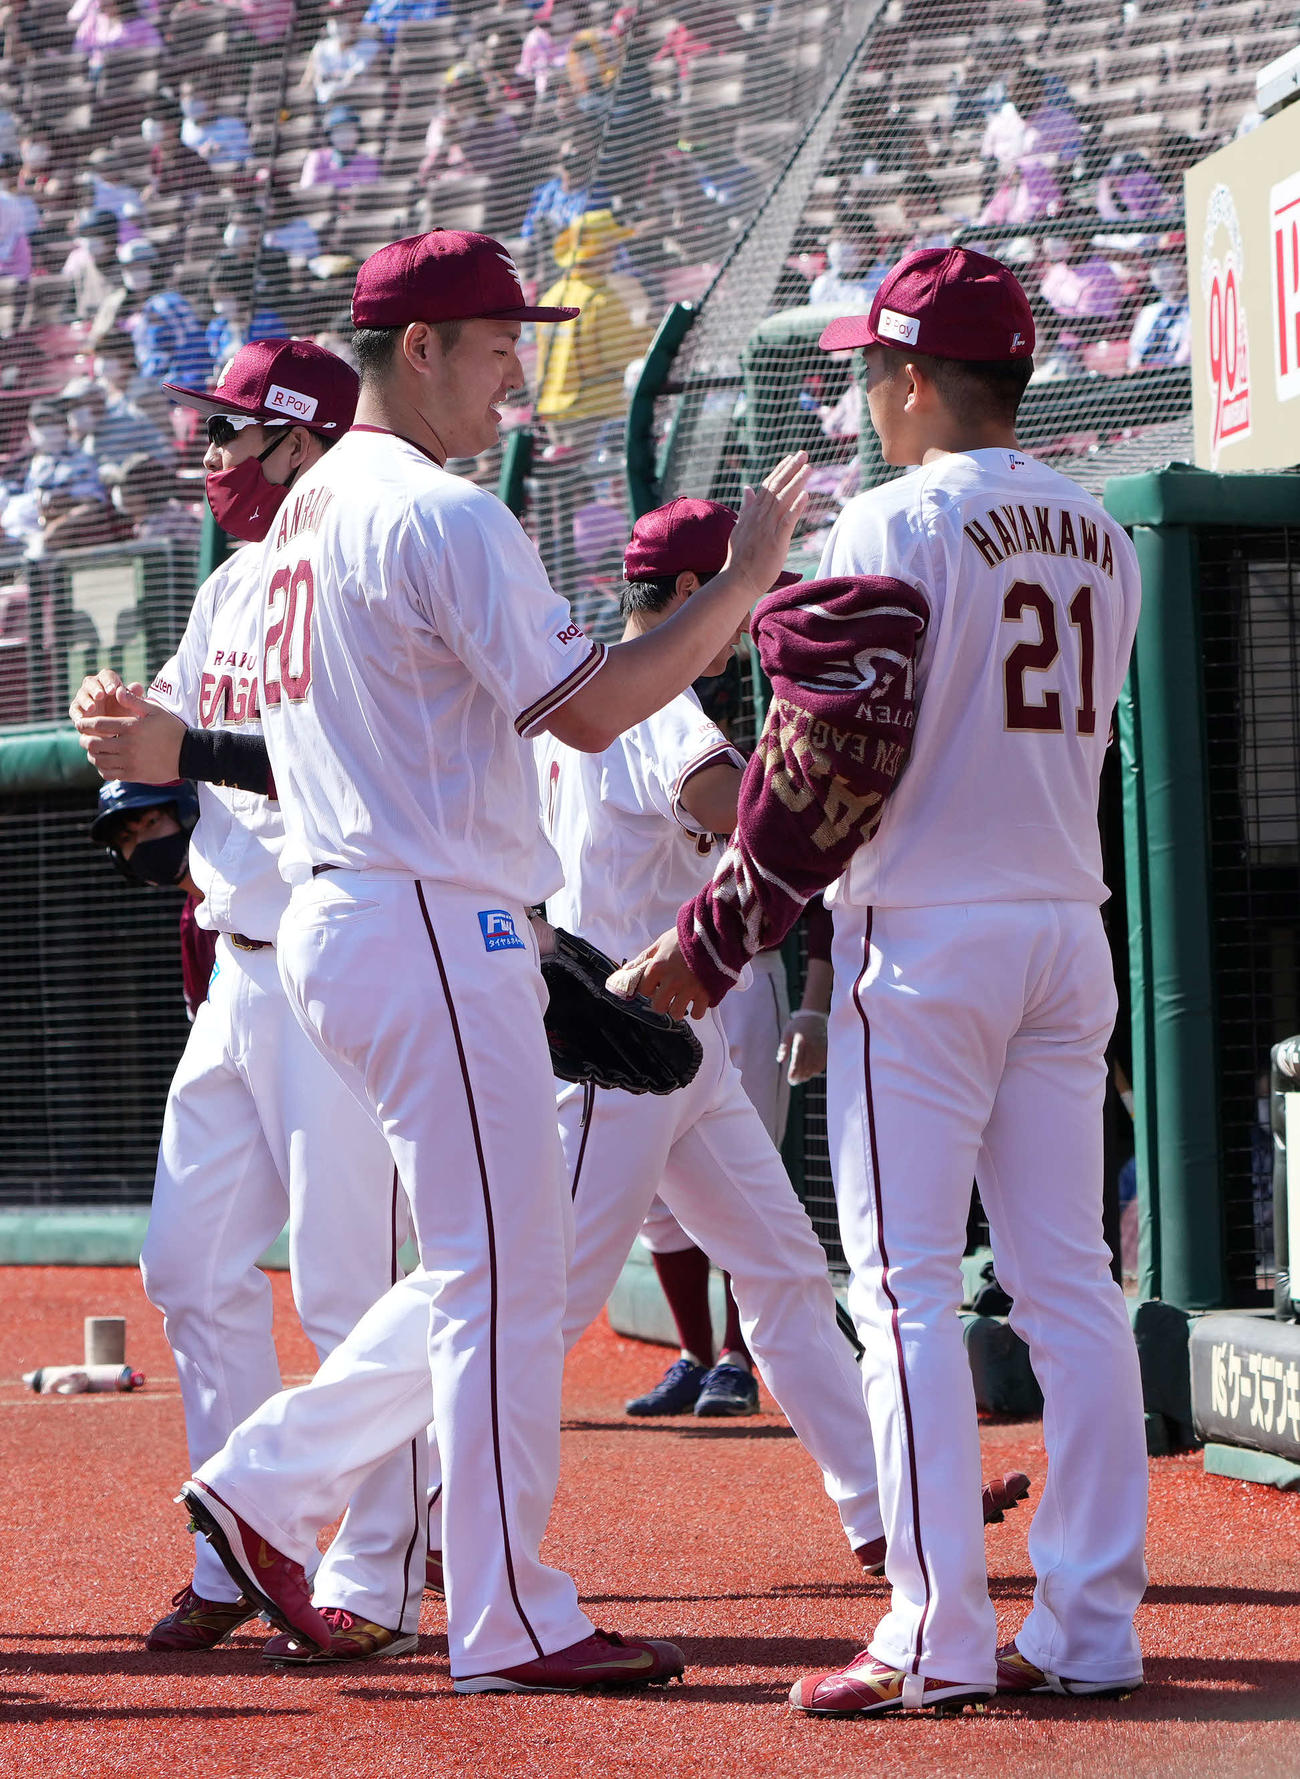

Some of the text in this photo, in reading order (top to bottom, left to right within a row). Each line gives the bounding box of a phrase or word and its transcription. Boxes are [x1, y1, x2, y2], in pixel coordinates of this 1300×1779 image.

[285, 395, 311, 415] Pay
[963, 504, 1114, 580] HAYAKAWA
[263, 558, 316, 708] 20
[1001, 578, 1097, 738] 21
